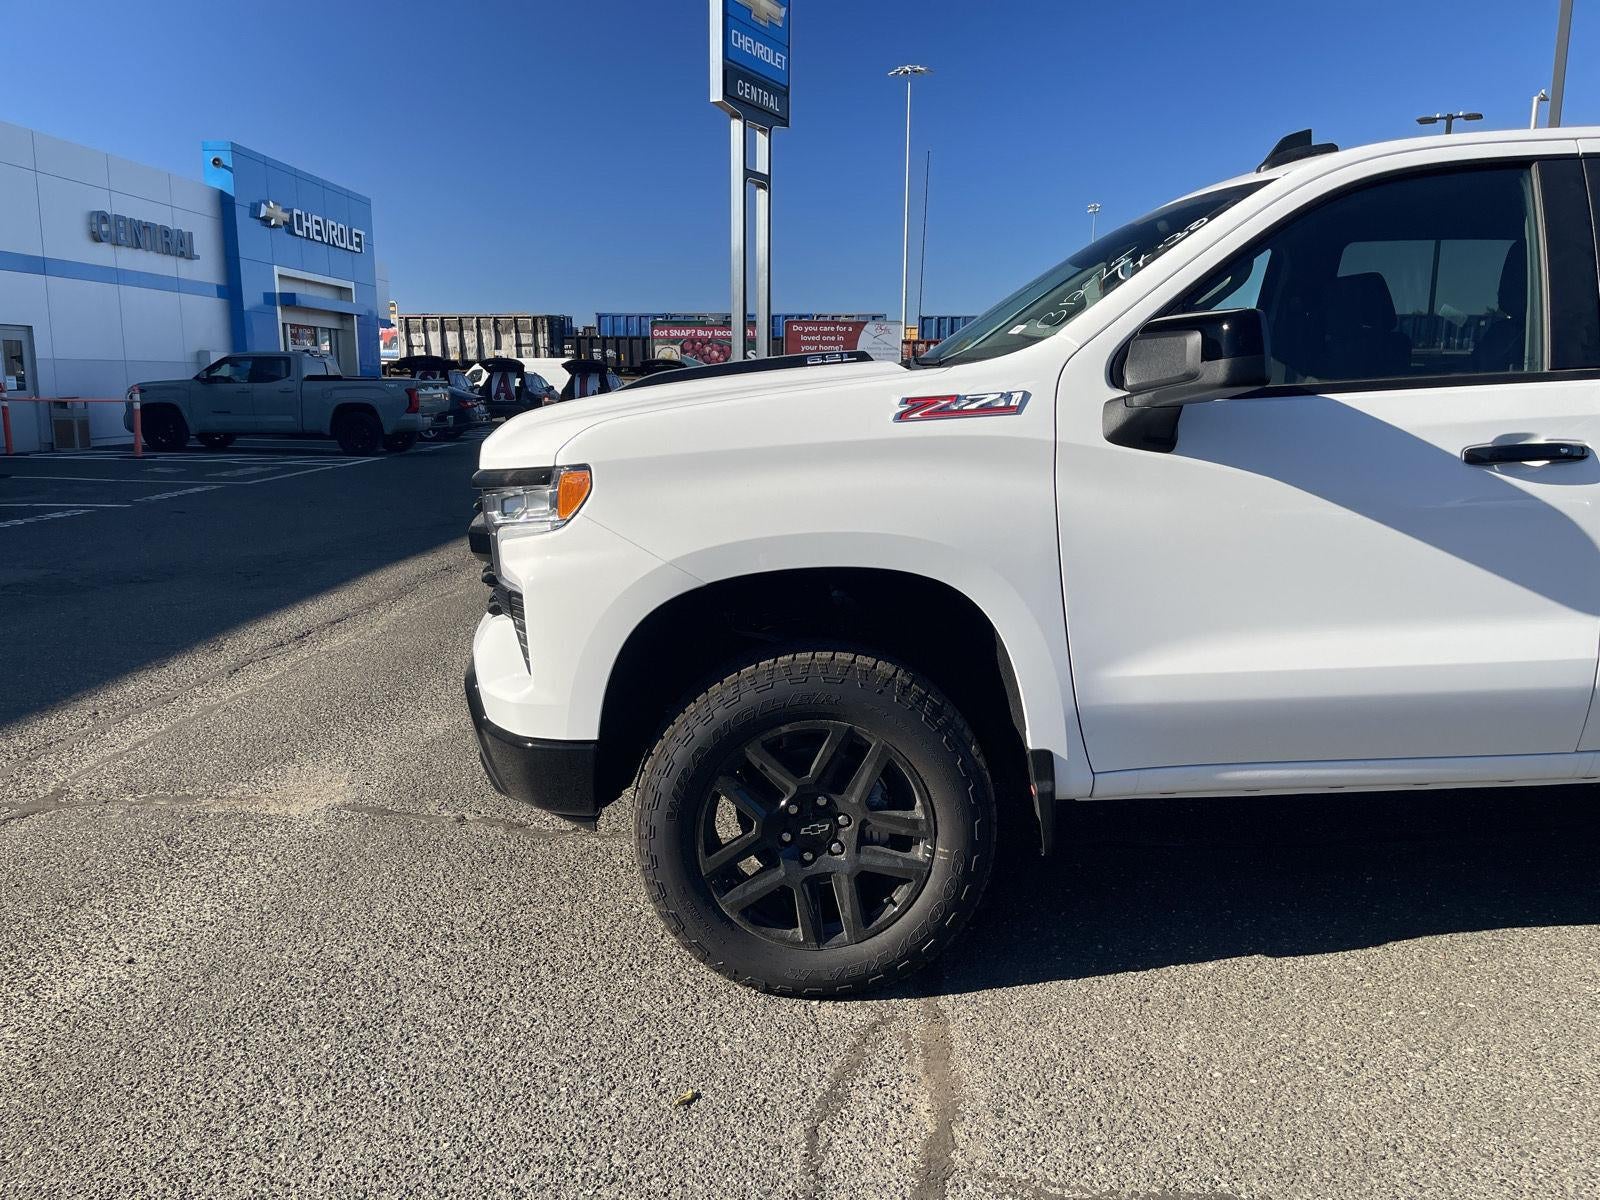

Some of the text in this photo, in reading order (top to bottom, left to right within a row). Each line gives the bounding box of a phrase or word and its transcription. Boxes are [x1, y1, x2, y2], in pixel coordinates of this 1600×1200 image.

[731, 29, 787, 71] CHEVROLET
[737, 79, 780, 112] CENTRAL
[88, 210, 200, 260] CENTRAL
[293, 208, 366, 253] CHEVROLET
[653, 329, 732, 339] Got SNAP? Buy loca
[836, 324, 847, 332] for
[819, 344, 844, 352] home?
[893, 390, 1032, 423] Z71
[665, 690, 843, 822] WRANGLER
[783, 849, 967, 982] GOODYEAR
